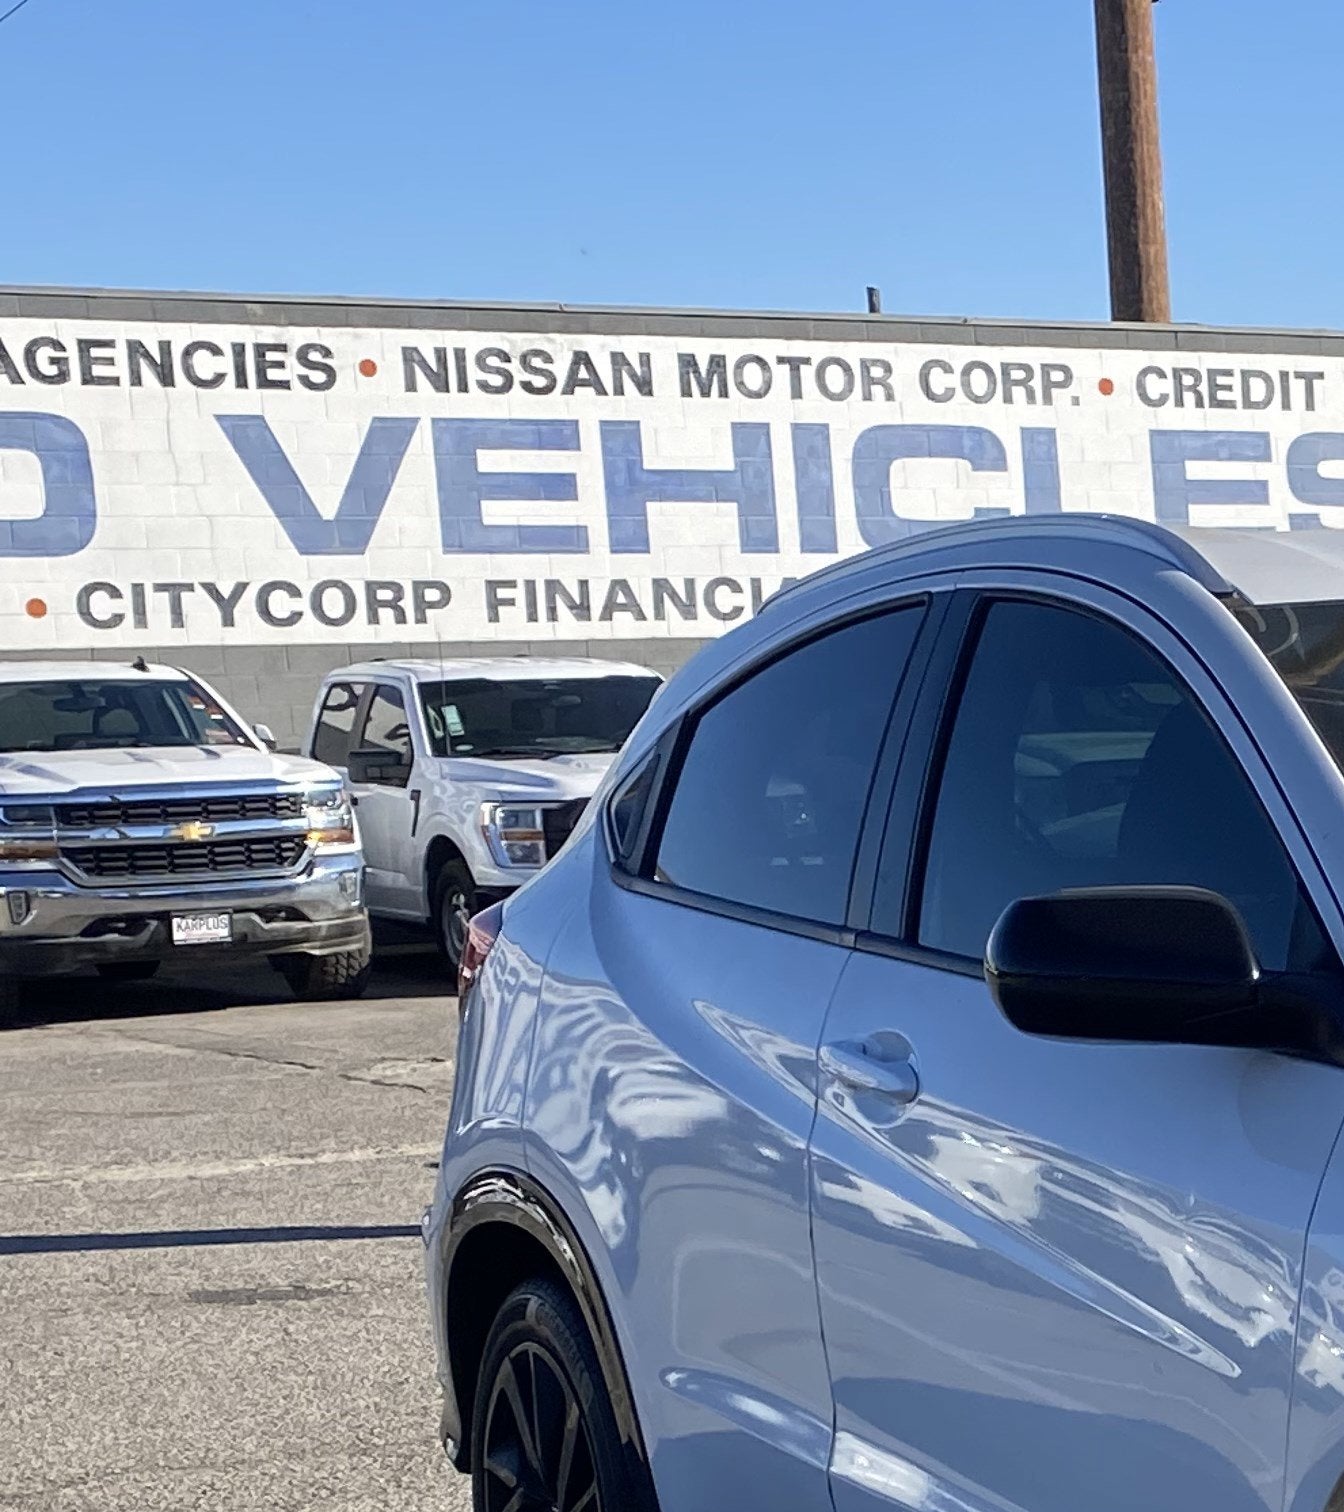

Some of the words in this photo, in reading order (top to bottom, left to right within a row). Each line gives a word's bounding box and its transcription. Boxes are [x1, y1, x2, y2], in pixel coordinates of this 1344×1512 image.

[0, 336, 337, 392] AGENCIES
[401, 346, 653, 397] NISSAN
[677, 352, 895, 401] MOTOR
[918, 359, 1080, 406] CORP.
[1135, 366, 1324, 411] CREDIT
[76, 579, 452, 629] CITYCORP
[485, 577, 797, 623] FINANCI
